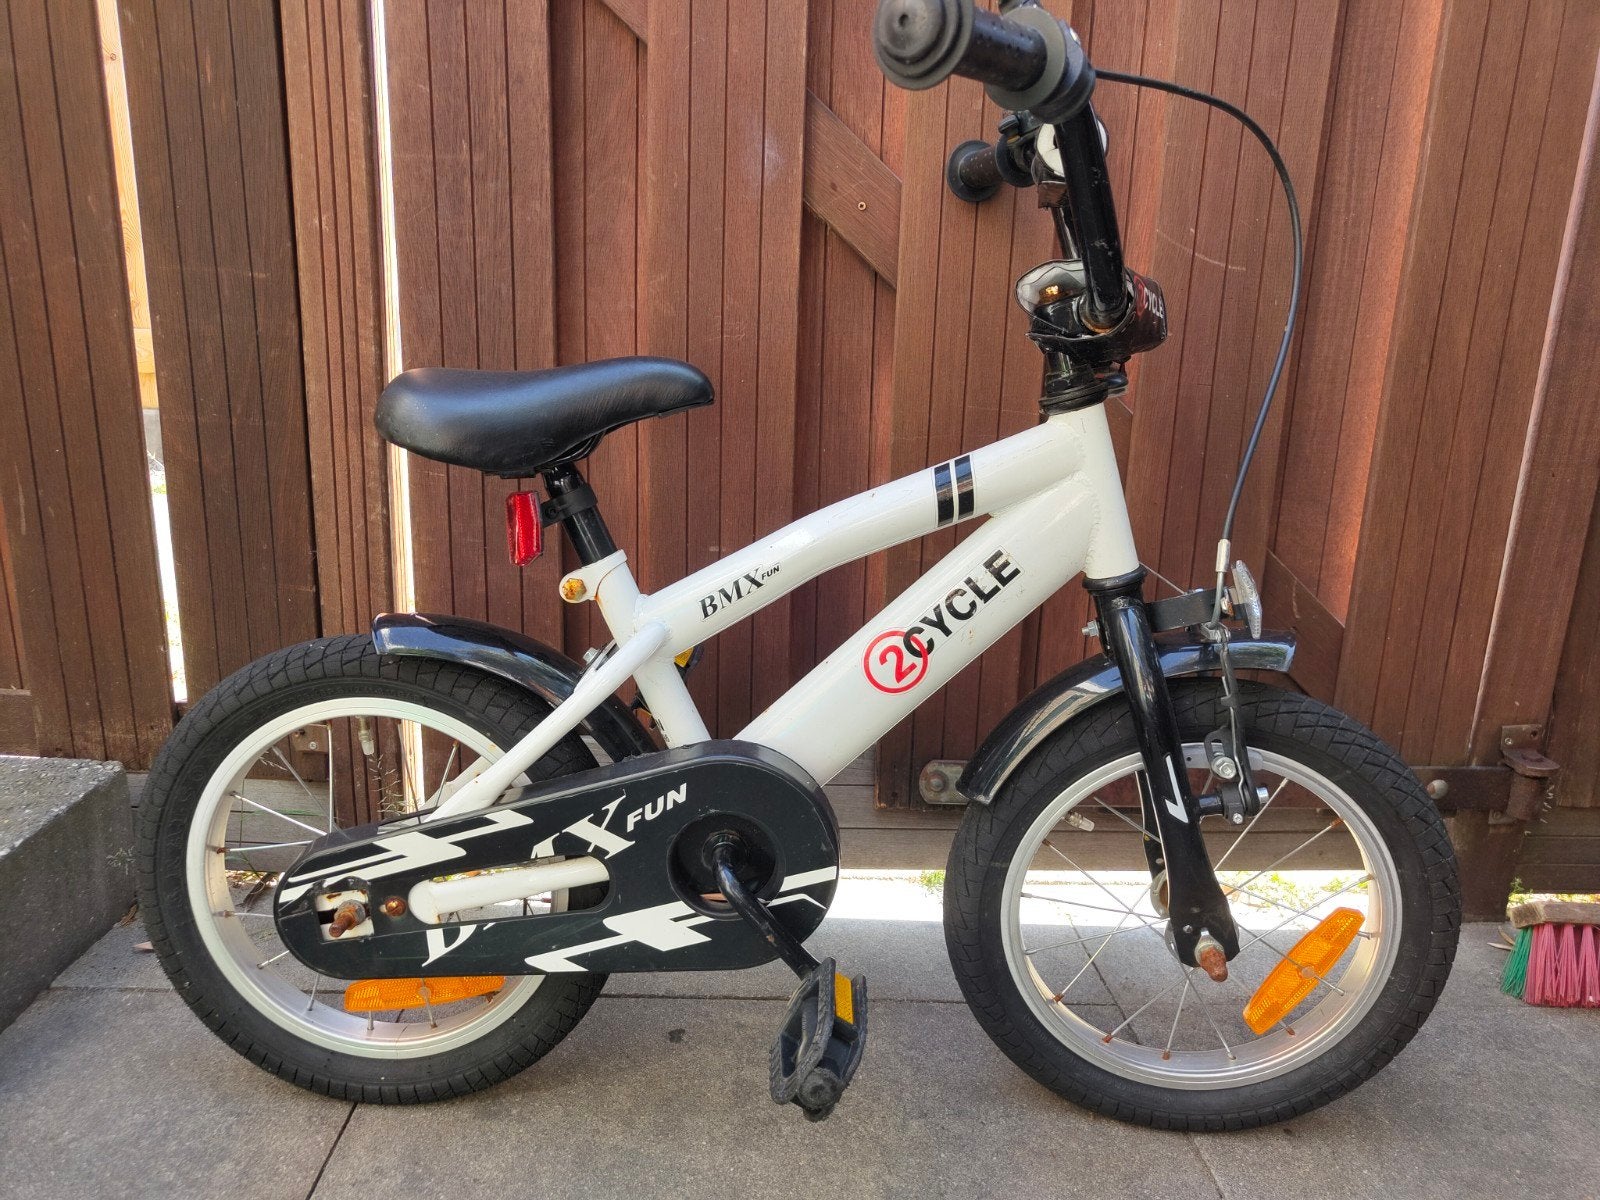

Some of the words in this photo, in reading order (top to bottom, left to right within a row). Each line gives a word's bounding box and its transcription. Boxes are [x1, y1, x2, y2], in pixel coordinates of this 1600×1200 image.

[699, 565, 765, 619] BMX
[761, 565, 780, 580] FUN
[626, 782, 687, 833] FUN
